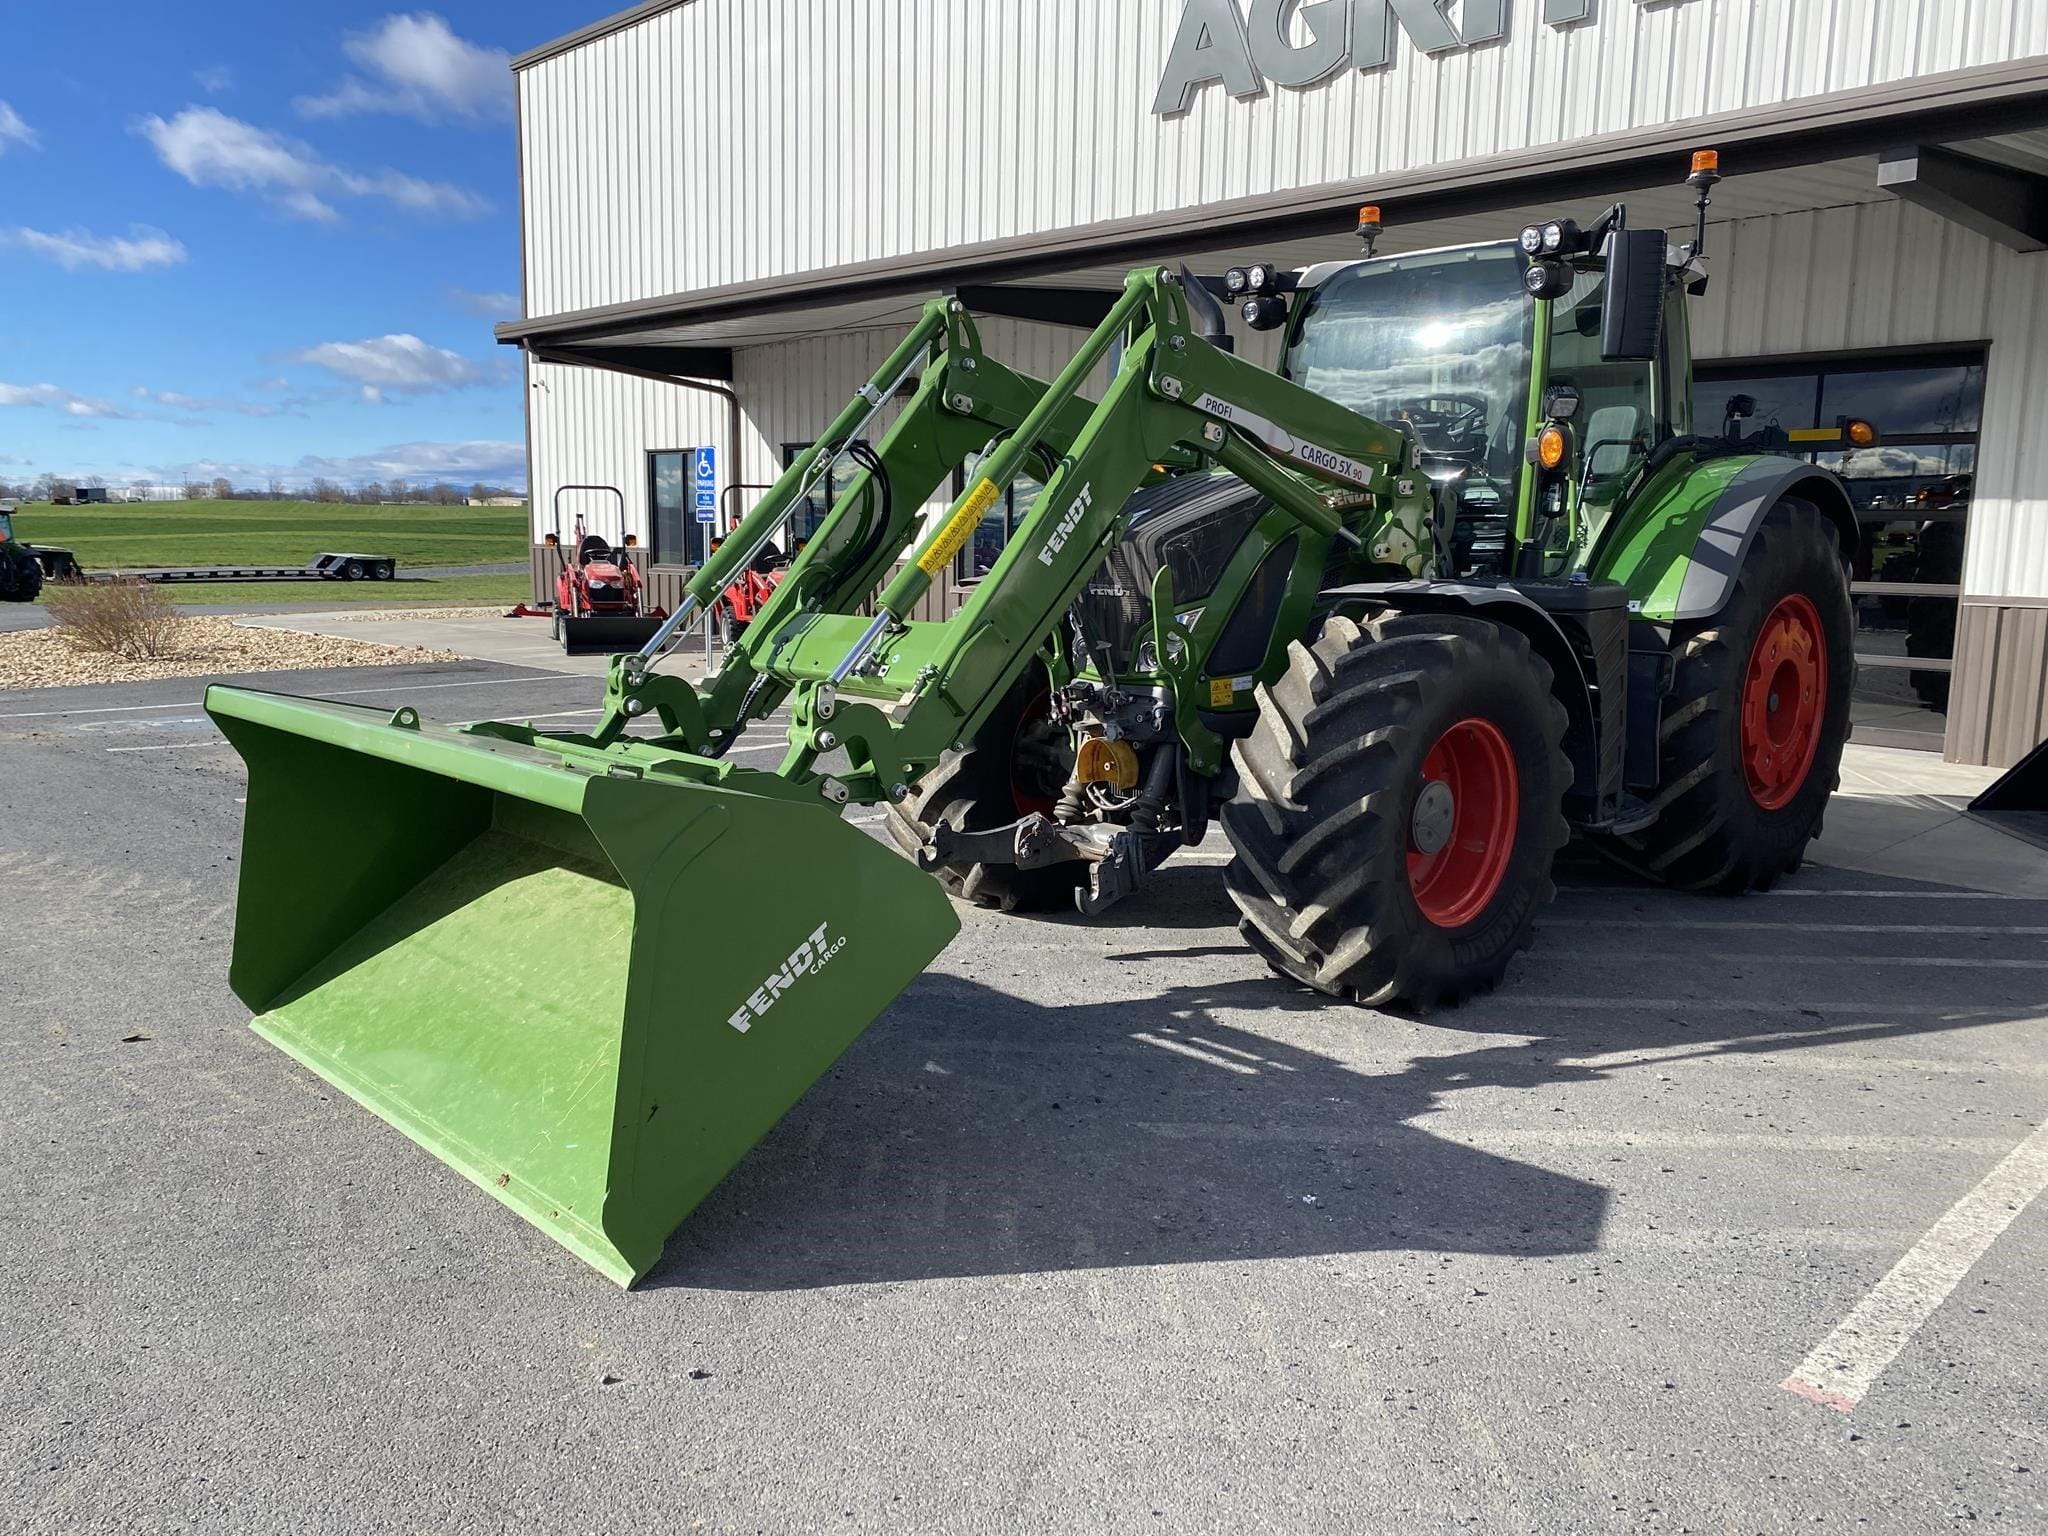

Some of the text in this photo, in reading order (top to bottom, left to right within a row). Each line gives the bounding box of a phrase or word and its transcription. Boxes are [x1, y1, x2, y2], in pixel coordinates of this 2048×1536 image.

[1205, 397, 1233, 419] PROFI
[1300, 444, 1363, 481] CARGO 5X 90
[1037, 480, 1093, 567] FENDT
[809, 936, 847, 975] CARGO
[727, 920, 828, 1034] FENDT
